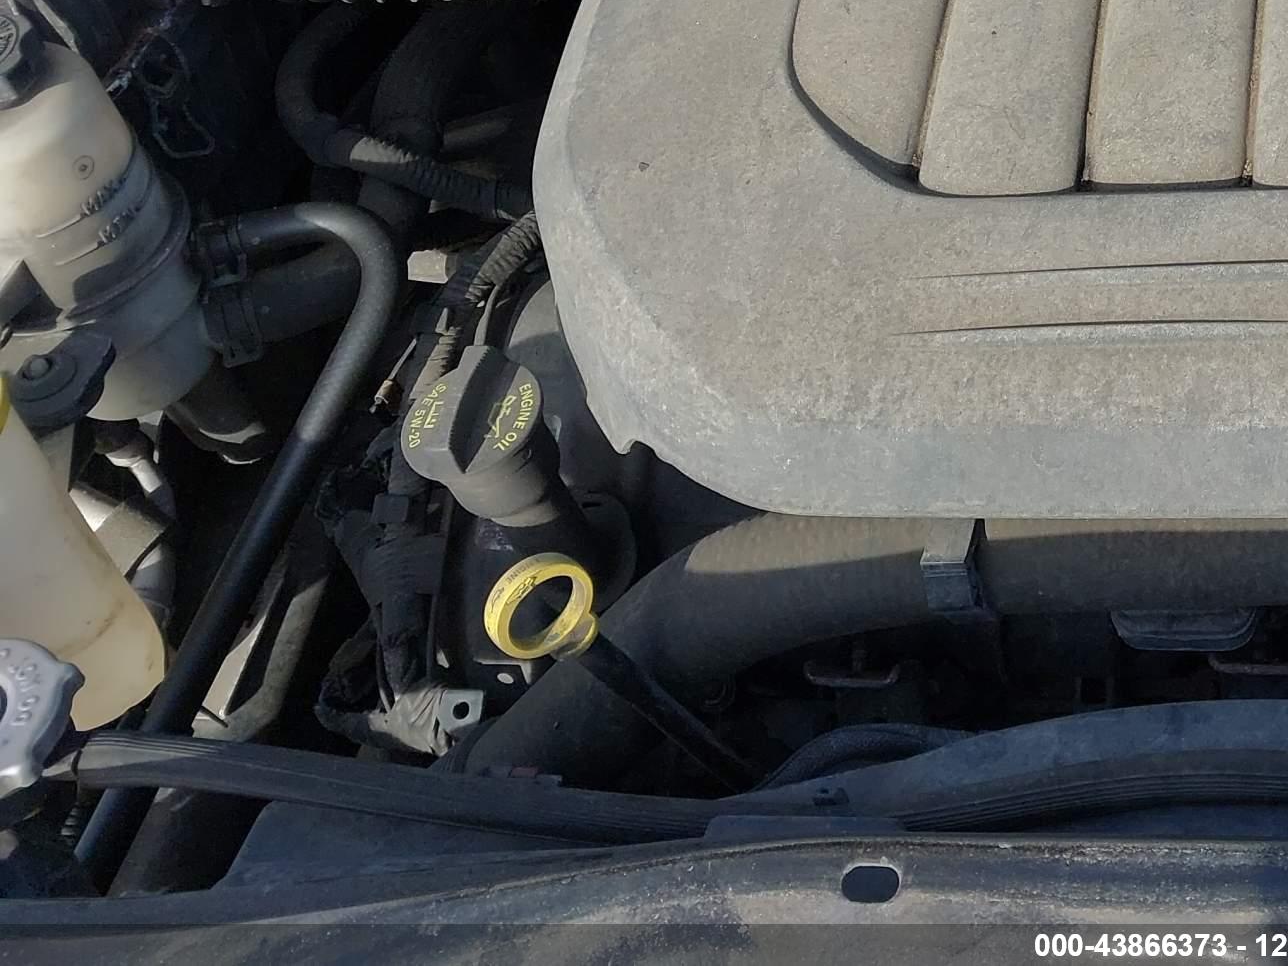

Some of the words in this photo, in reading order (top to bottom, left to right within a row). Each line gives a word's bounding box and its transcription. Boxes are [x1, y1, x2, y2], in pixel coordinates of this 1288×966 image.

[422, 383, 447, 406] SAE
[512, 383, 535, 431] ENGINE
[408, 409, 426, 449] 5W-20
[493, 432, 518, 452] OIL
